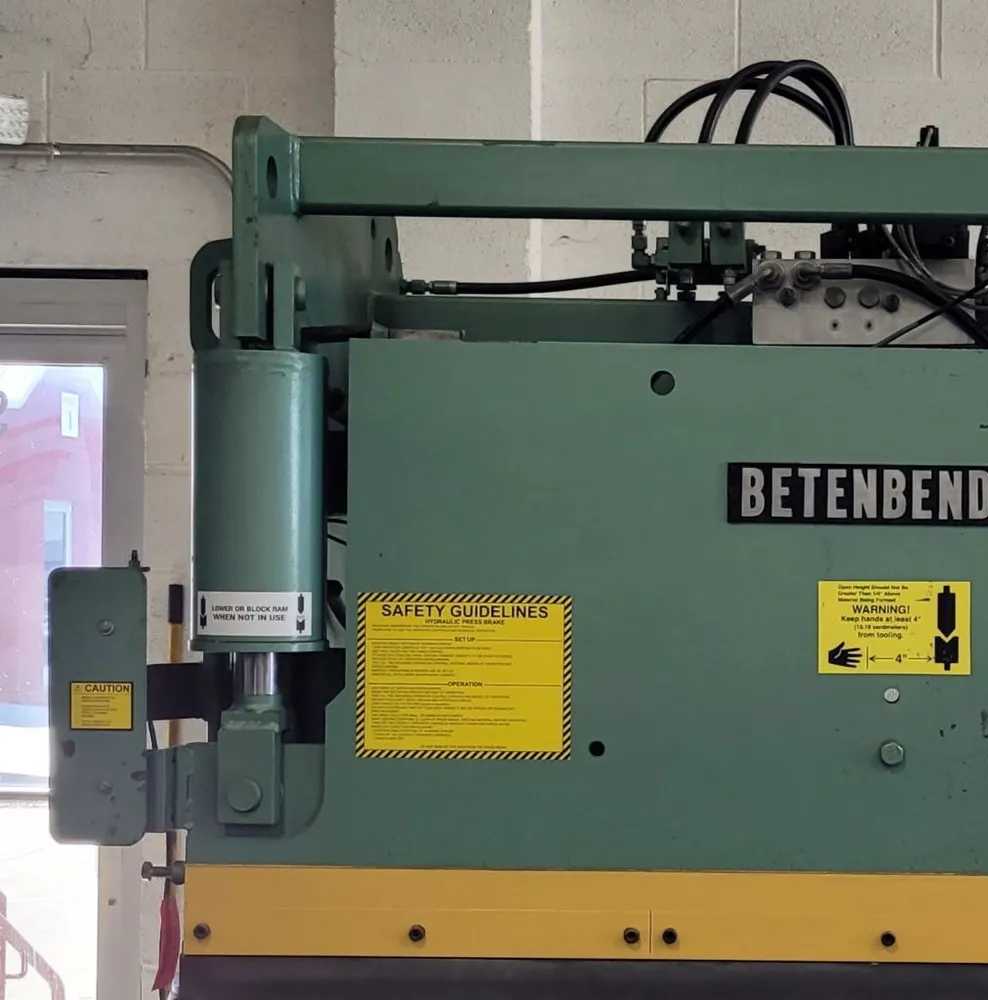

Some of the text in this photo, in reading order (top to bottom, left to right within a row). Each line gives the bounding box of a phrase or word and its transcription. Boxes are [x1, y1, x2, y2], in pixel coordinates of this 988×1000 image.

[381, 604, 548, 619] SAFETY GUIDELINES
[852, 605, 910, 614] WARNING!
[895, 653, 907, 664] 4"
[85, 684, 130, 692] CAUTION
